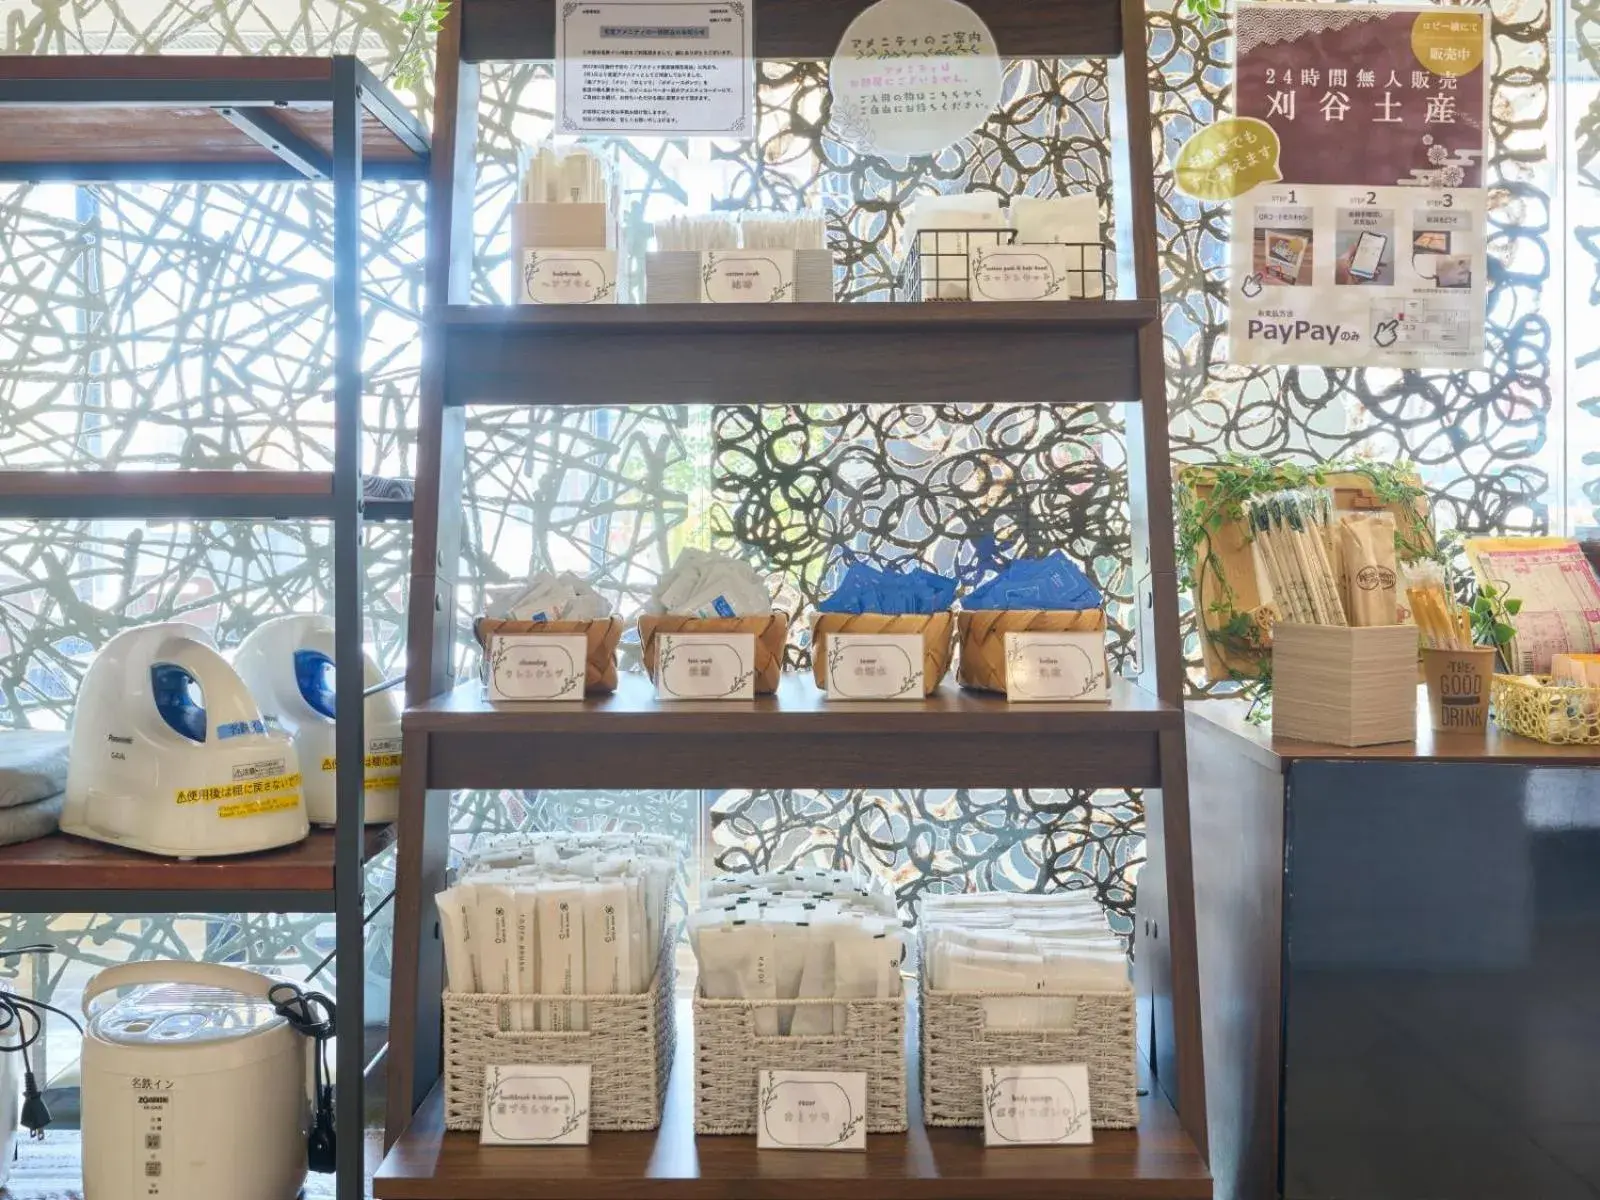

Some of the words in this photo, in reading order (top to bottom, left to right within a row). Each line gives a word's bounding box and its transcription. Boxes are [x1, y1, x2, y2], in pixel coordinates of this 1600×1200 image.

[850, 31, 982, 49] アメニティのご案内
[1429, 46, 1471, 61] 販売中
[1265, 67, 1457, 89] 24時間無人販売
[1266, 90, 1456, 124] 刈谷土産
[1288, 190, 1297, 204] 1
[1366, 191, 1377, 205] 2
[1443, 193, 1453, 208] 3
[1248, 318, 1361, 346] PayPayのみ
[1450, 661, 1472, 674] THE
[1440, 674, 1482, 695] GOOD
[1441, 705, 1483, 727] DRINK
[131, 1077, 174, 1090] 名鉄イン
